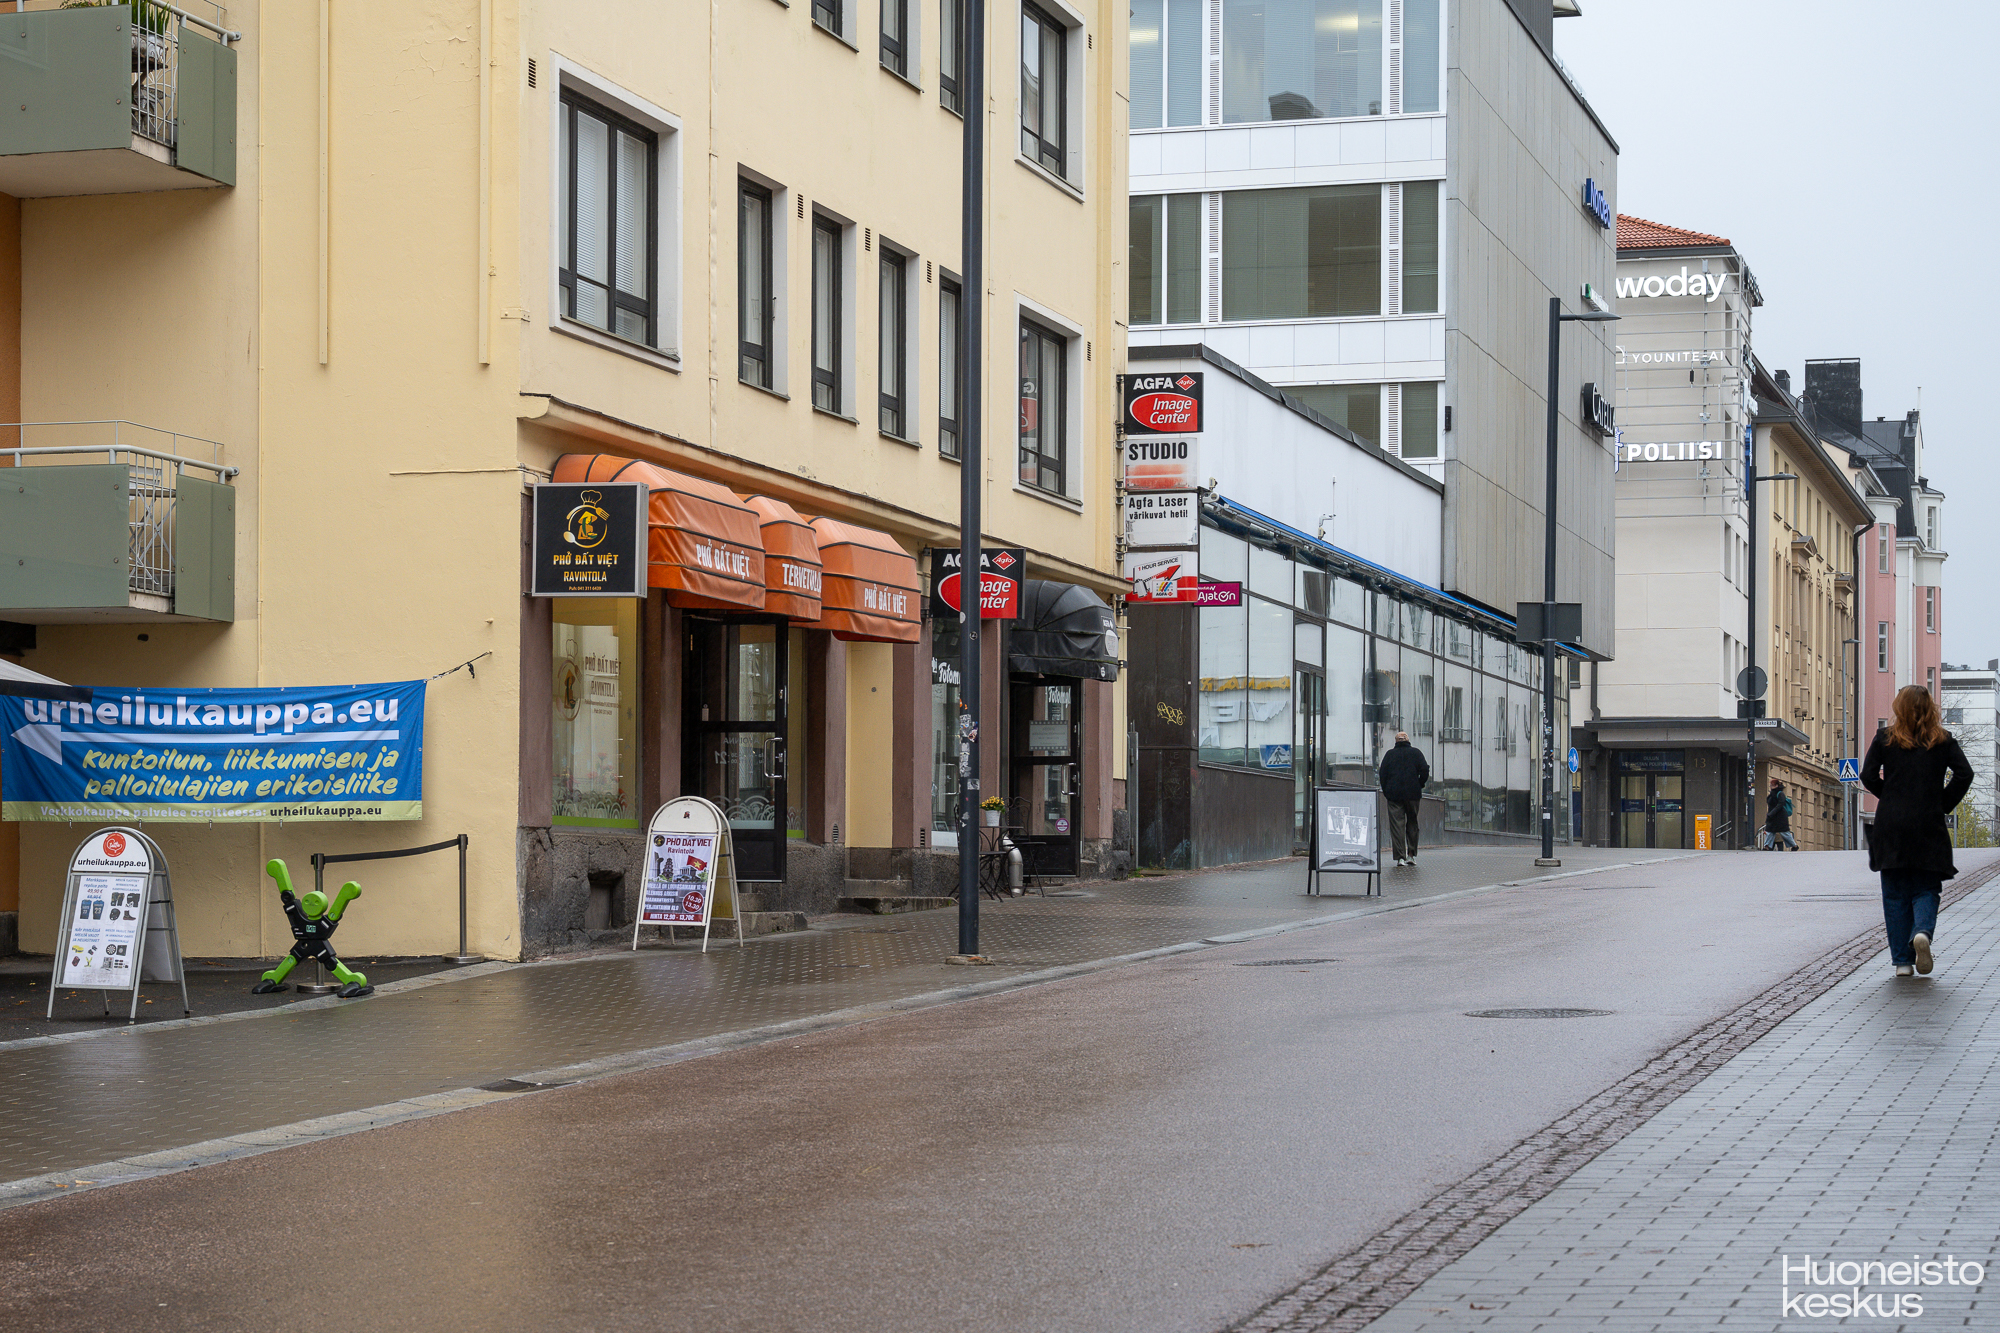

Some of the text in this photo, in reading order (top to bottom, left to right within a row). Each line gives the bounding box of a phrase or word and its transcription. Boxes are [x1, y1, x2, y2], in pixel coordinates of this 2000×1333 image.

[1616, 267, 1727, 302] woday
[1632, 350, 1724, 363] YOUNITE-AI
[1133, 378, 1194, 390] AGFA Agfa
[1153, 398, 1192, 413] Image
[1150, 411, 1190, 425] Center
[1128, 442, 1188, 461] STUDIO
[1627, 441, 1722, 462] POLIISI
[1128, 497, 1188, 511] Agfa Laser
[1129, 510, 1188, 521] värikuvat heti!
[553, 551, 619, 567] PHỞ ĐẤT VIỆT
[943, 554, 990, 567] AA
[1142, 562, 1157, 570] HOUR
[1157, 557, 1179, 567] SERVICE
[563, 571, 607, 582] RAVINTOLA
[782, 563, 821, 593] TERVETULO
[980, 580, 1011, 597] age
[980, 594, 1010, 609] nter
[24, 696, 399, 733] urheilukauppa.eu
[223, 747, 368, 771] liikkumisen
[367, 745, 399, 772] ja
[1694, 758, 1706, 768] 13
[83, 772, 399, 801] palloilulajien erikoisliike
[41, 806, 382, 819] Verkkokauppa palvelee osoitteessa: urheilukauppa.eu
[1698, 830, 1707, 849] posti
[667, 847, 695, 855] Ravintola
[77, 858, 147, 868] urheilukauppa.eu
